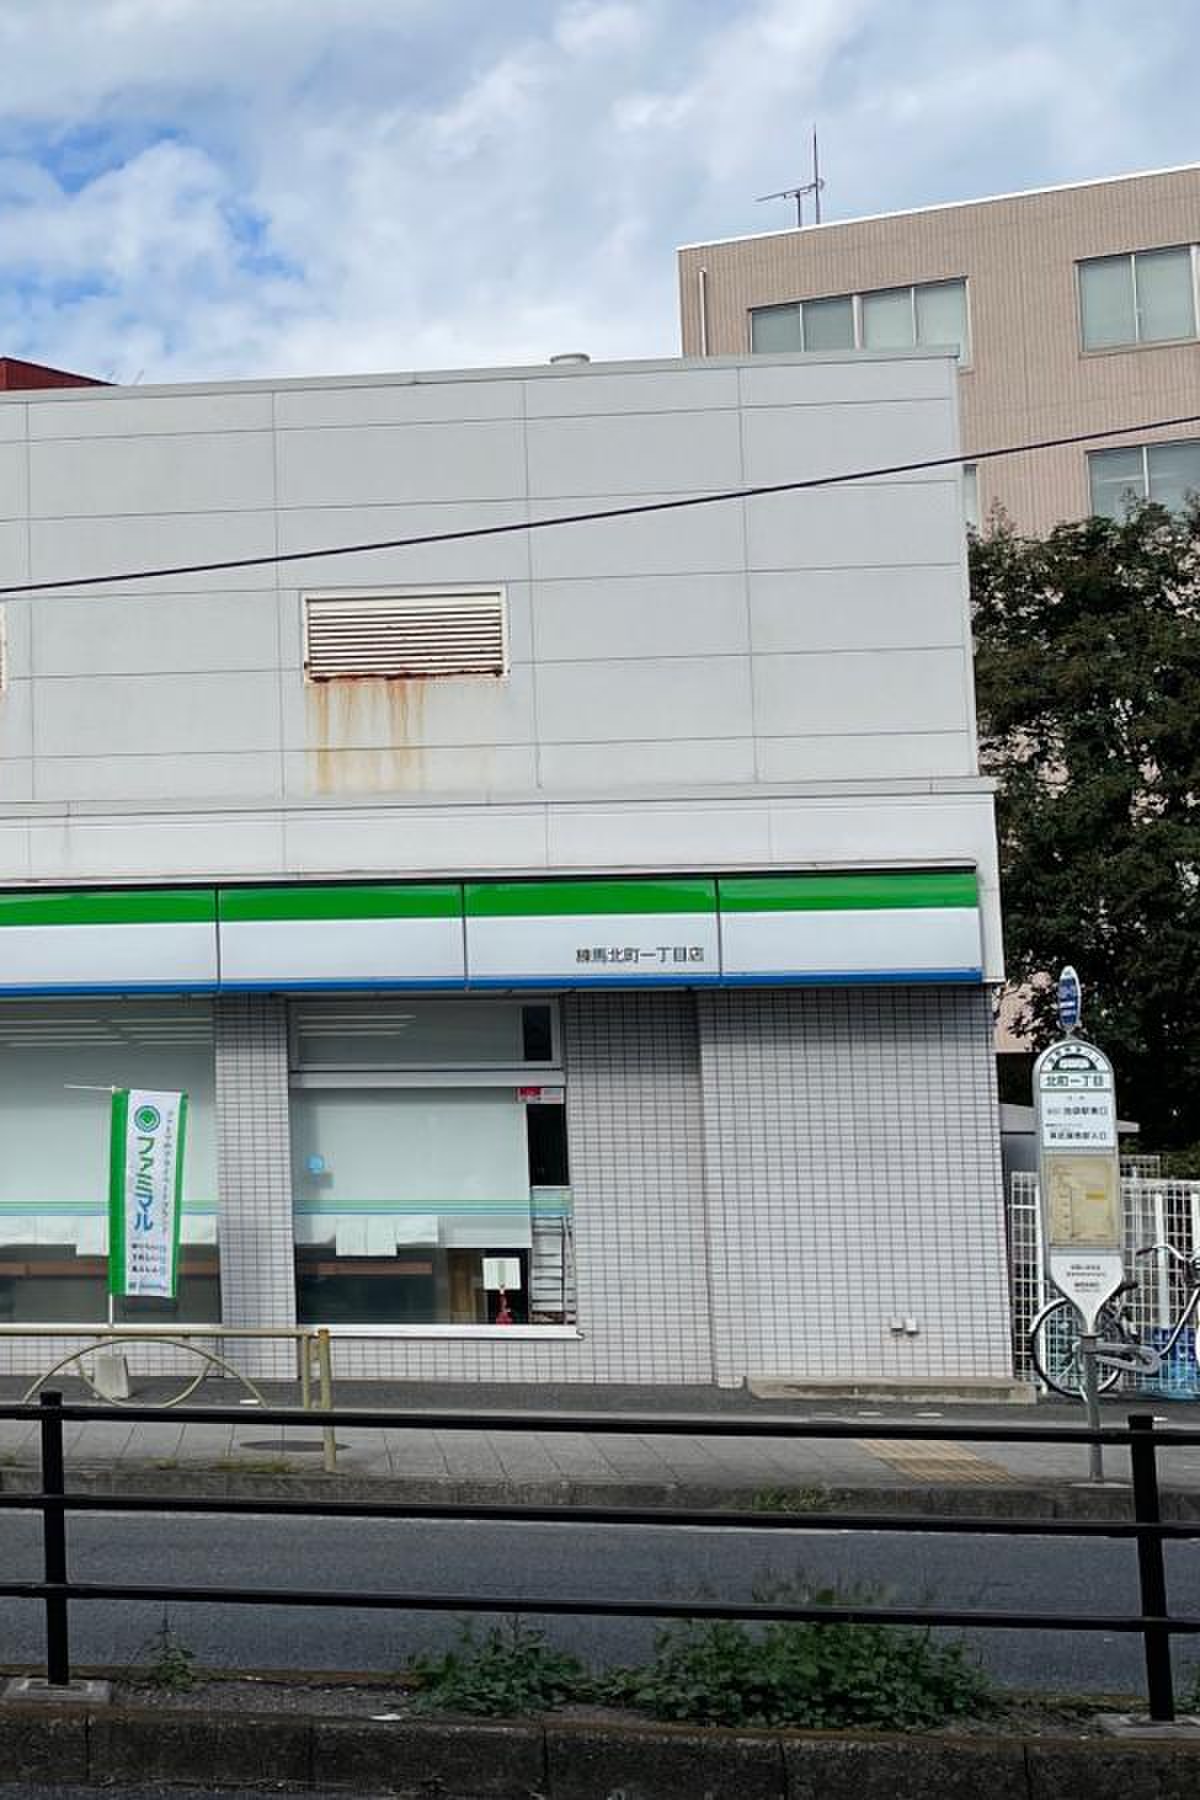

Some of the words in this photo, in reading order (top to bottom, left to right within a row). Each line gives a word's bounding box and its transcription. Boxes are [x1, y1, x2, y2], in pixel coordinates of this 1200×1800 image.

[575, 945, 705, 963] 練馬北町一丁目店
[1046, 1075, 1104, 1087] 北町一丁目
[134, 1135, 155, 1231] ファミマル
